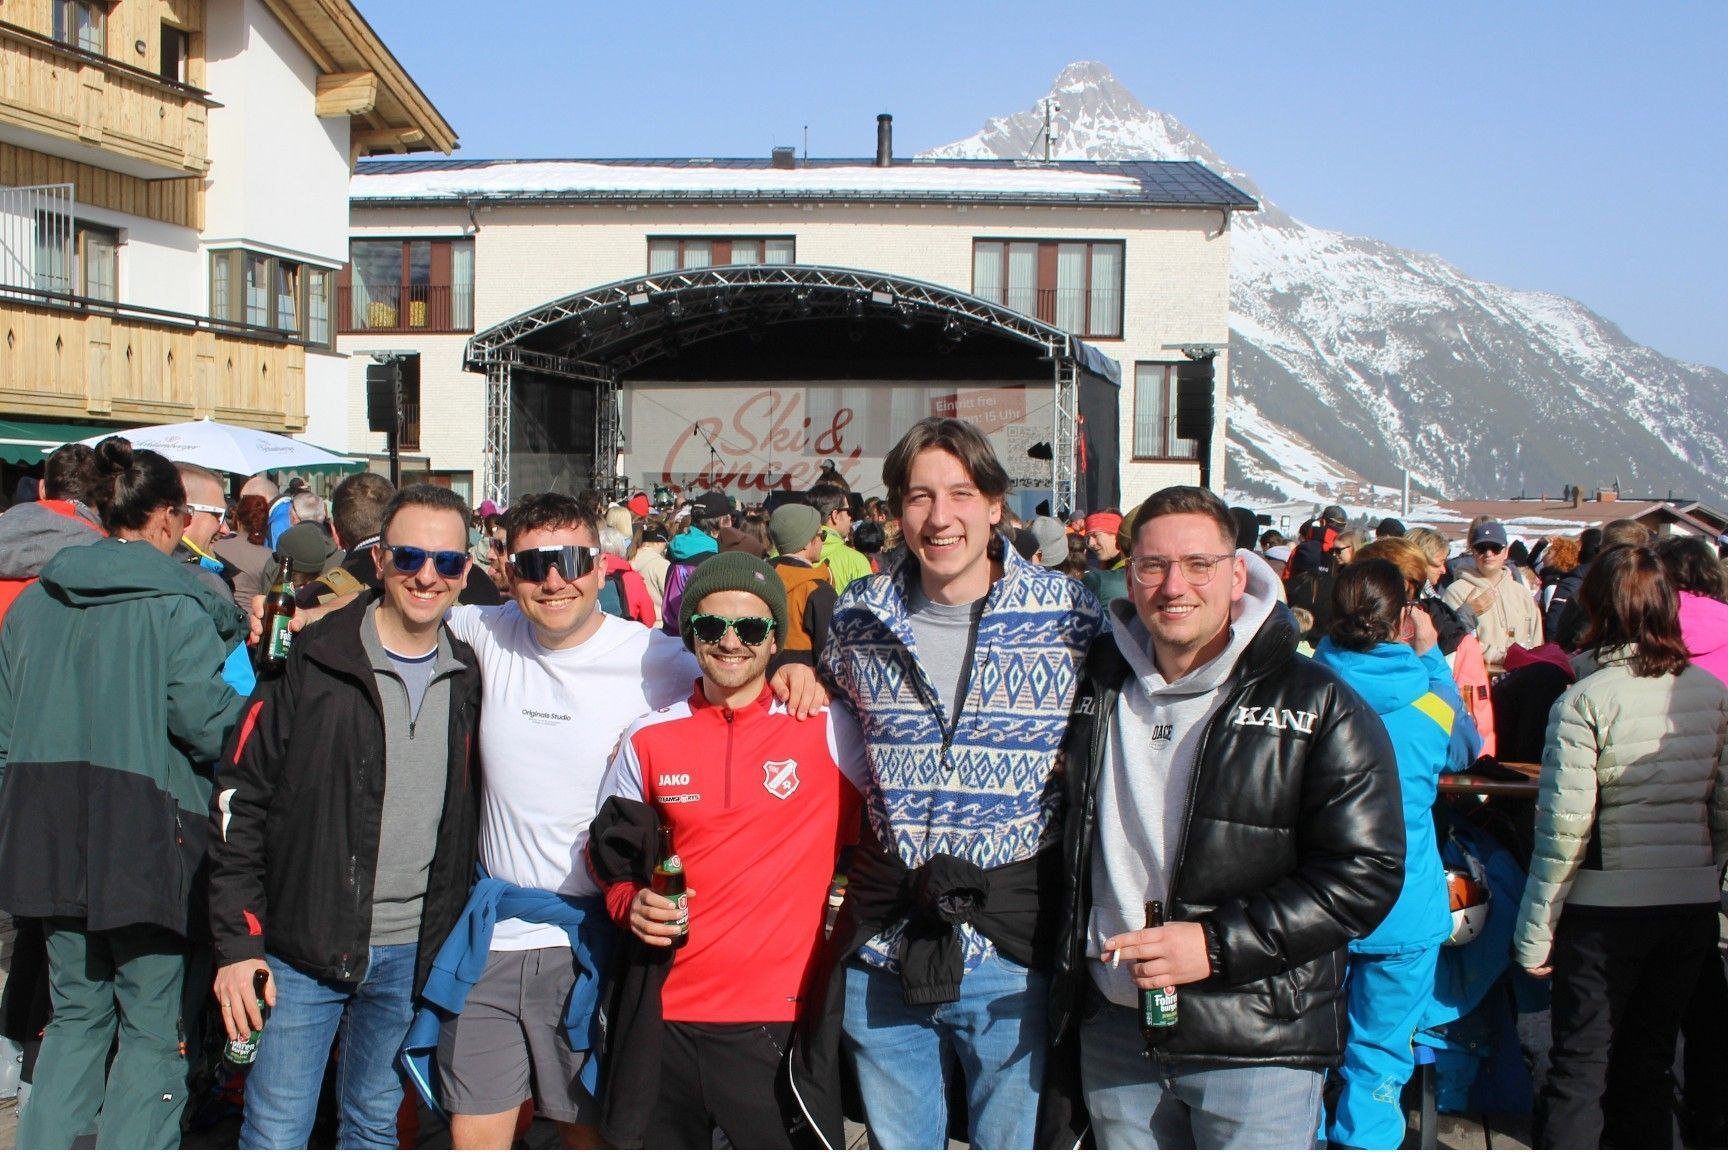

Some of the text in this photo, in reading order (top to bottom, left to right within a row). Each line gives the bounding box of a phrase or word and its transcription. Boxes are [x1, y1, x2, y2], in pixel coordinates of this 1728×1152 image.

[936, 397, 997, 412] Eintritt frei
[985, 411, 996, 422] 15
[999, 409, 1020, 420] Uhr
[721, 390, 854, 457] Ski &
[661, 416, 864, 494] Concert
[521, 708, 572, 721] Originals Studio
[1234, 705, 1319, 735] KANI
[658, 773, 690, 787] JAKO
[230, 1040, 256, 1052] ohren
